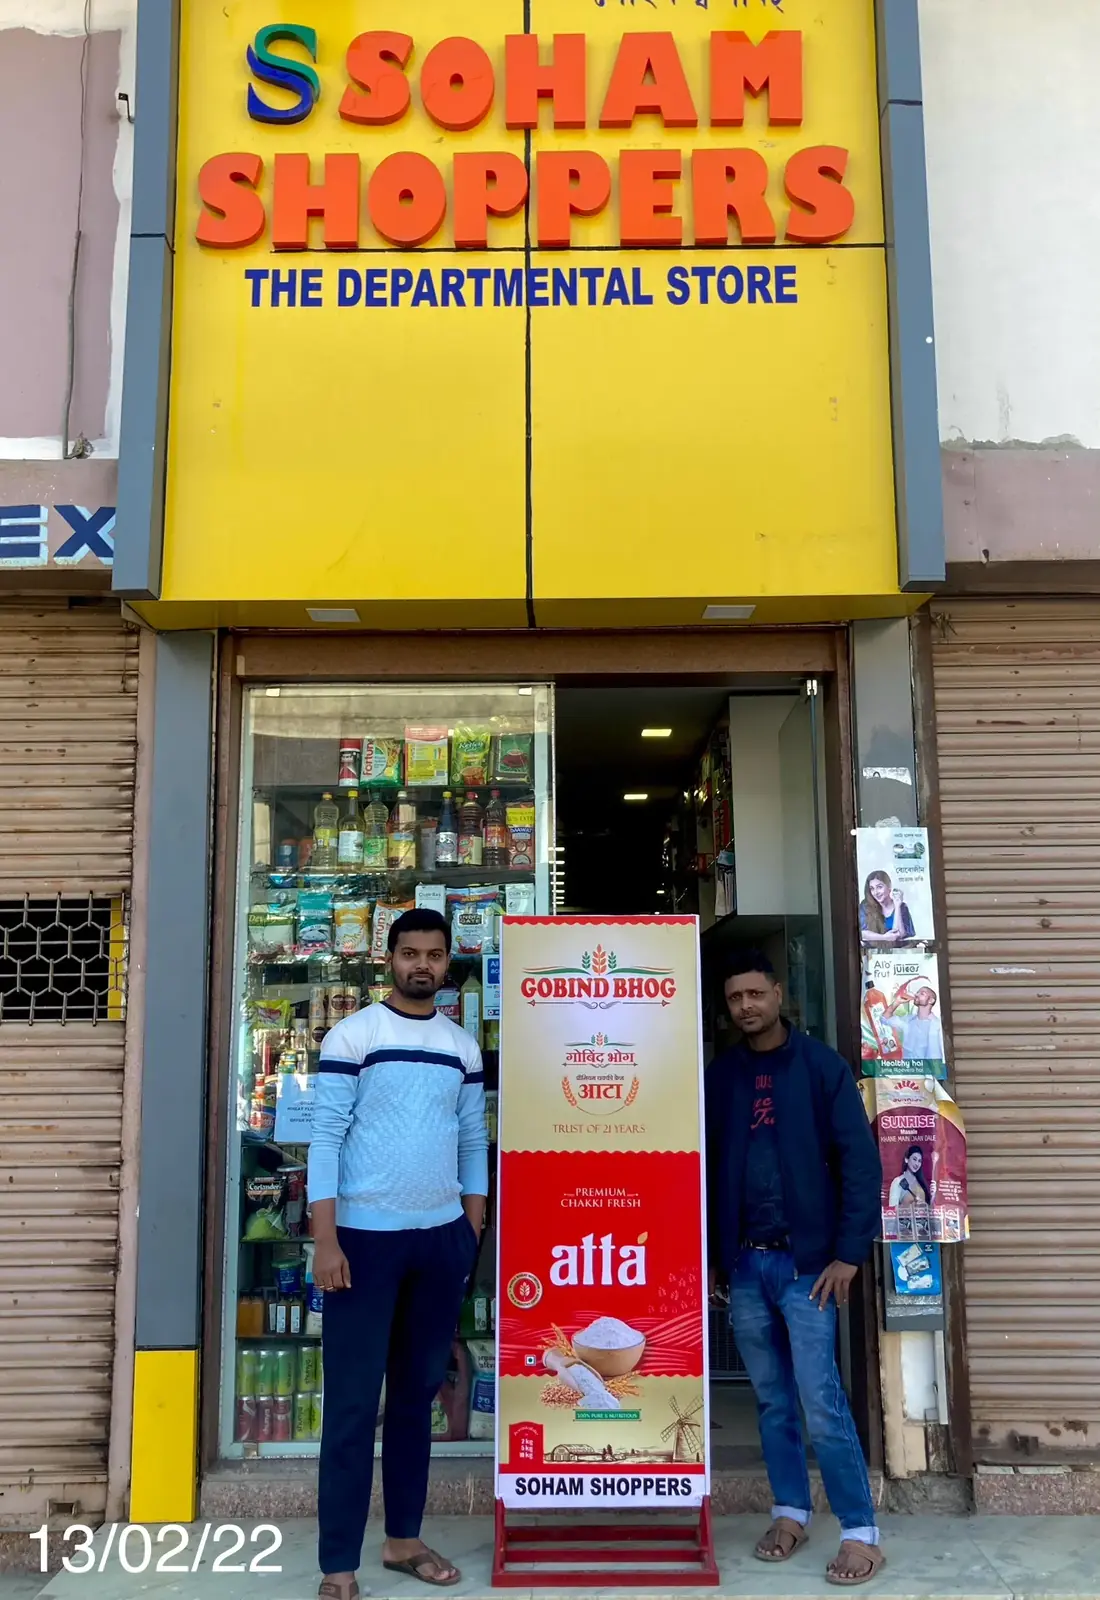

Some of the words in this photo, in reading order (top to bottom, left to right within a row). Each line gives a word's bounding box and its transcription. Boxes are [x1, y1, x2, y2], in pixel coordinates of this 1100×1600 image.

[338, 30, 803, 132] SOHAM
[195, 145, 855, 250] SHOPPERS
[245, 268, 323, 307] THE
[337, 267, 653, 307] DEPARTMENTAL
[667, 265, 798, 305] STORE
[373, 910, 386, 953] fortune
[893, 964, 920, 975] juices
[520, 977, 609, 998] GOBIND
[613, 977, 676, 998] BHOG
[566, 1049, 605, 1063] गोबिंद
[607, 1049, 635, 1063] भोग
[881, 1059, 910, 1067] Healthy
[912, 1059, 923, 1067] hai
[578, 1083, 623, 1099] आटा
[553, 1124, 583, 1134] TRUST
[586, 1124, 600, 1133] OF
[603, 1124, 611, 1133] 21
[613, 1124, 646, 1134] YEARS
[881, 1115, 935, 1128] SUNRISE
[249, 1182, 280, 1190] Coriander
[575, 1187, 627, 1197] PREMIUM
[560, 1198, 603, 1208] CHAKKI
[607, 1198, 641, 1208] FRESH
[549, 1232, 647, 1287] atta
[515, 1477, 584, 1496] SOHAM
[590, 1476, 692, 1496] SHOPPERS
